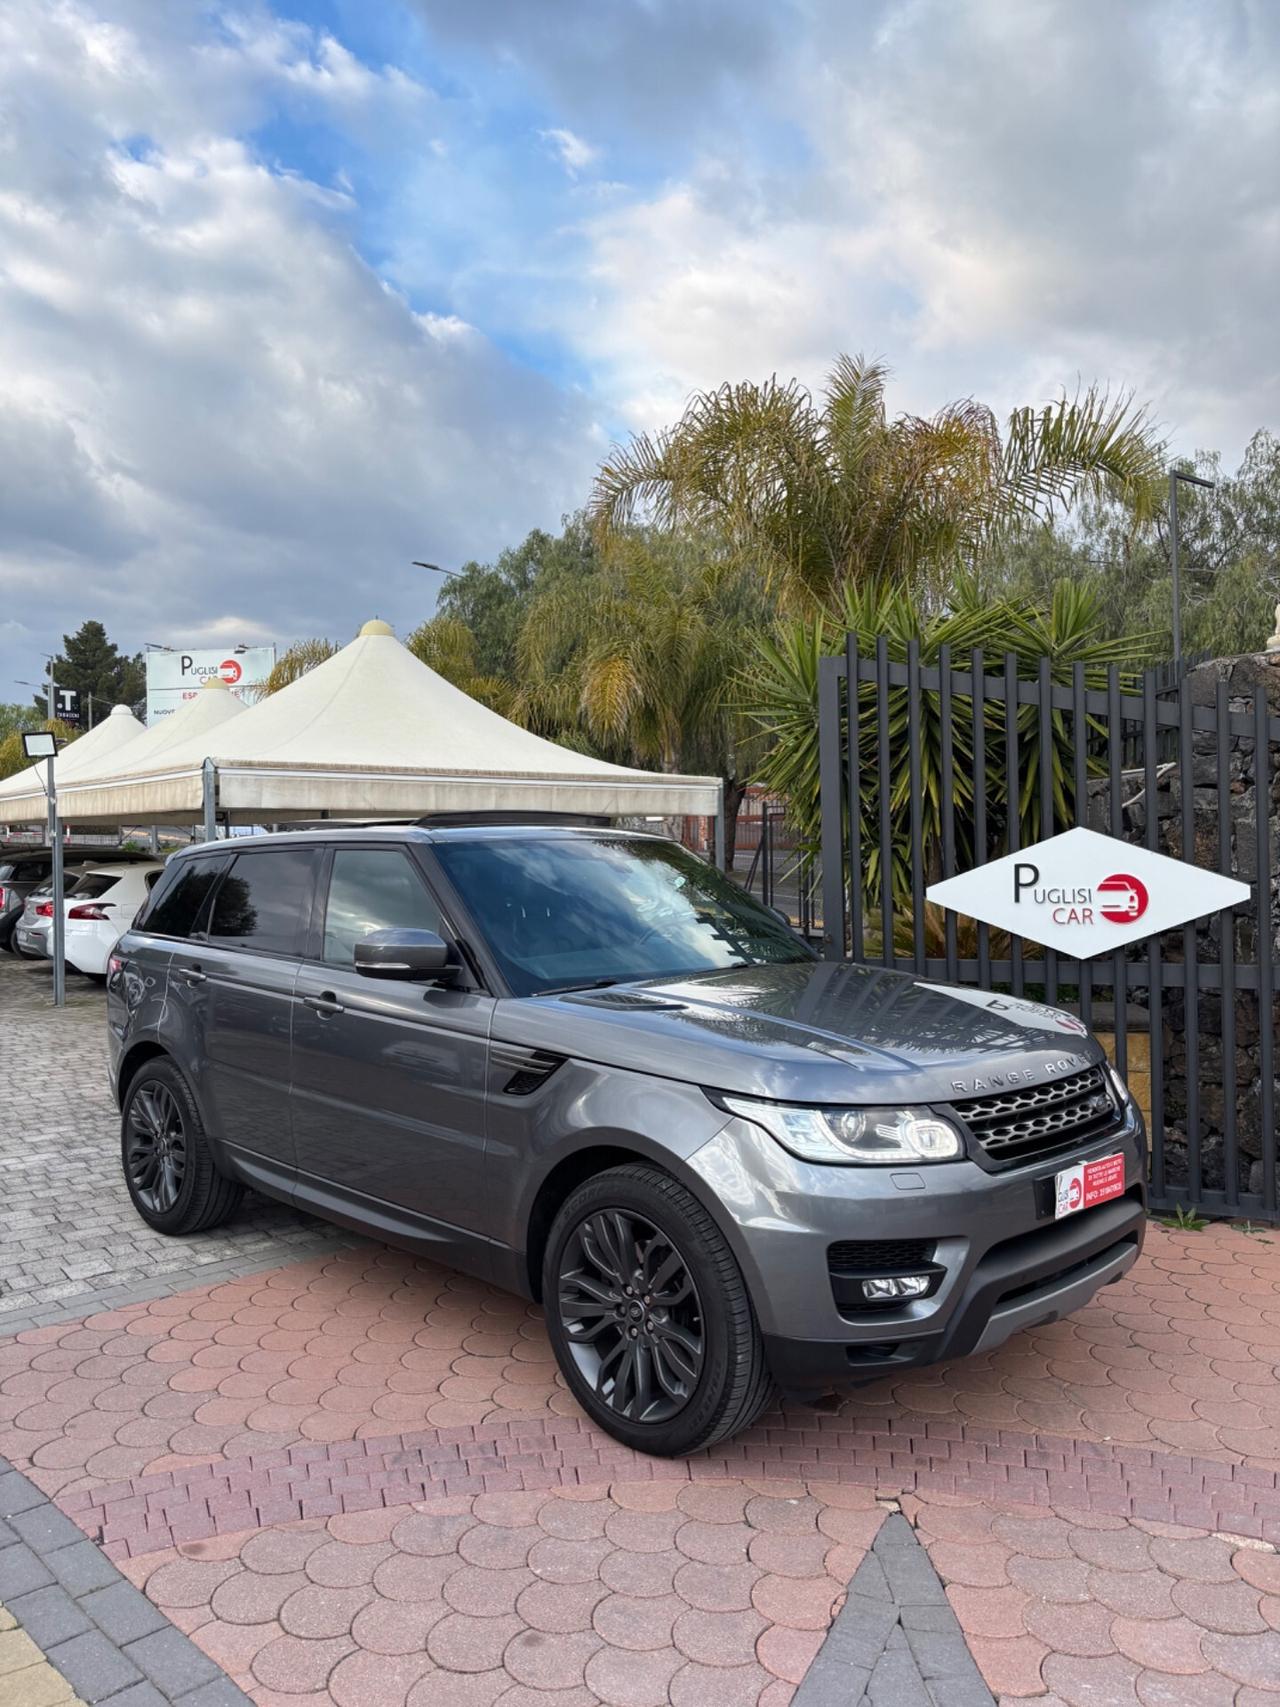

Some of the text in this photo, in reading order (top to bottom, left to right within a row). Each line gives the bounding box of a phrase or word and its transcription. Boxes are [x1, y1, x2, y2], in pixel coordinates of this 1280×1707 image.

[181, 655, 218, 676] PUGLISI
[1014, 863, 1092, 904] PUGLISI
[1053, 907, 1094, 925] CAR
[950, 1069, 1035, 1093] RANGE
